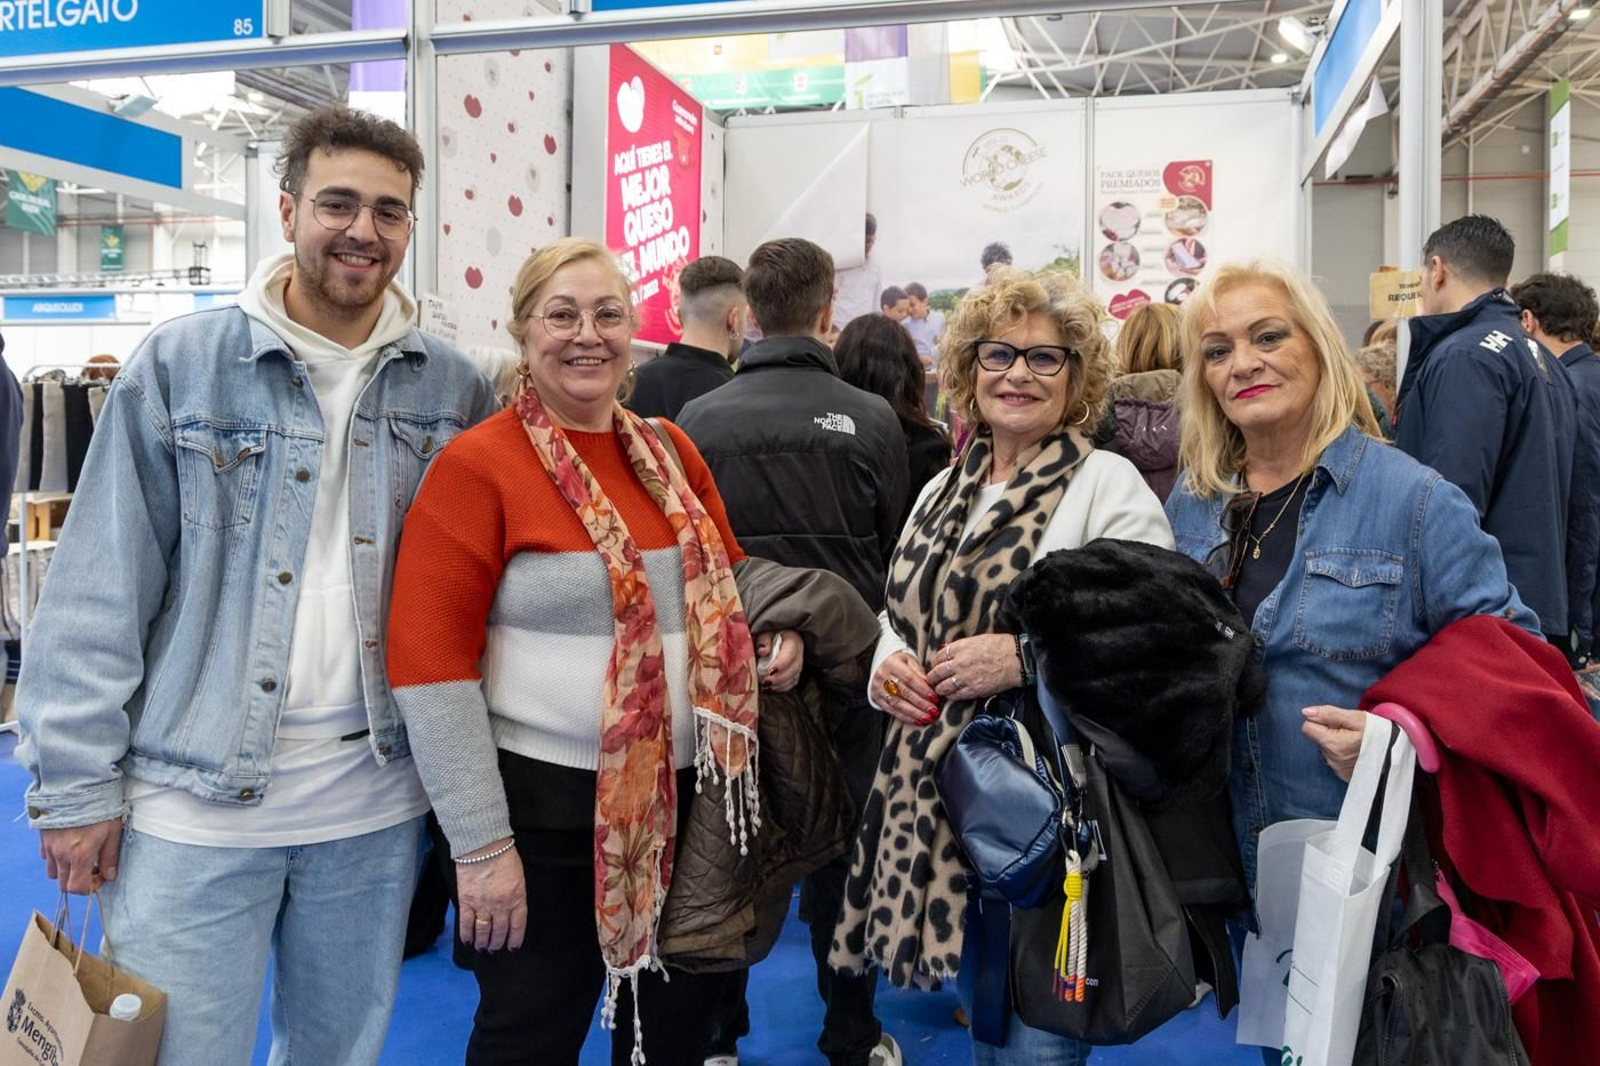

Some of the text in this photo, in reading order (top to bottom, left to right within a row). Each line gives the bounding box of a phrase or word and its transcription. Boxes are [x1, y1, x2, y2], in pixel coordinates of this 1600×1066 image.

[233, 18, 254, 35] 85
[614, 140, 672, 176] AQUÍ TIENES EL
[1100, 168, 1161, 179] PACK QUESOS
[621, 166, 671, 210] MEJOR
[1100, 178, 1161, 189] PREMIADOS
[624, 198, 673, 247] QUESO
[640, 225, 690, 277] MUNDO
[814, 416, 842, 426] NORTH
[826, 412, 842, 420] THE
[822, 423, 842, 432] FACE
